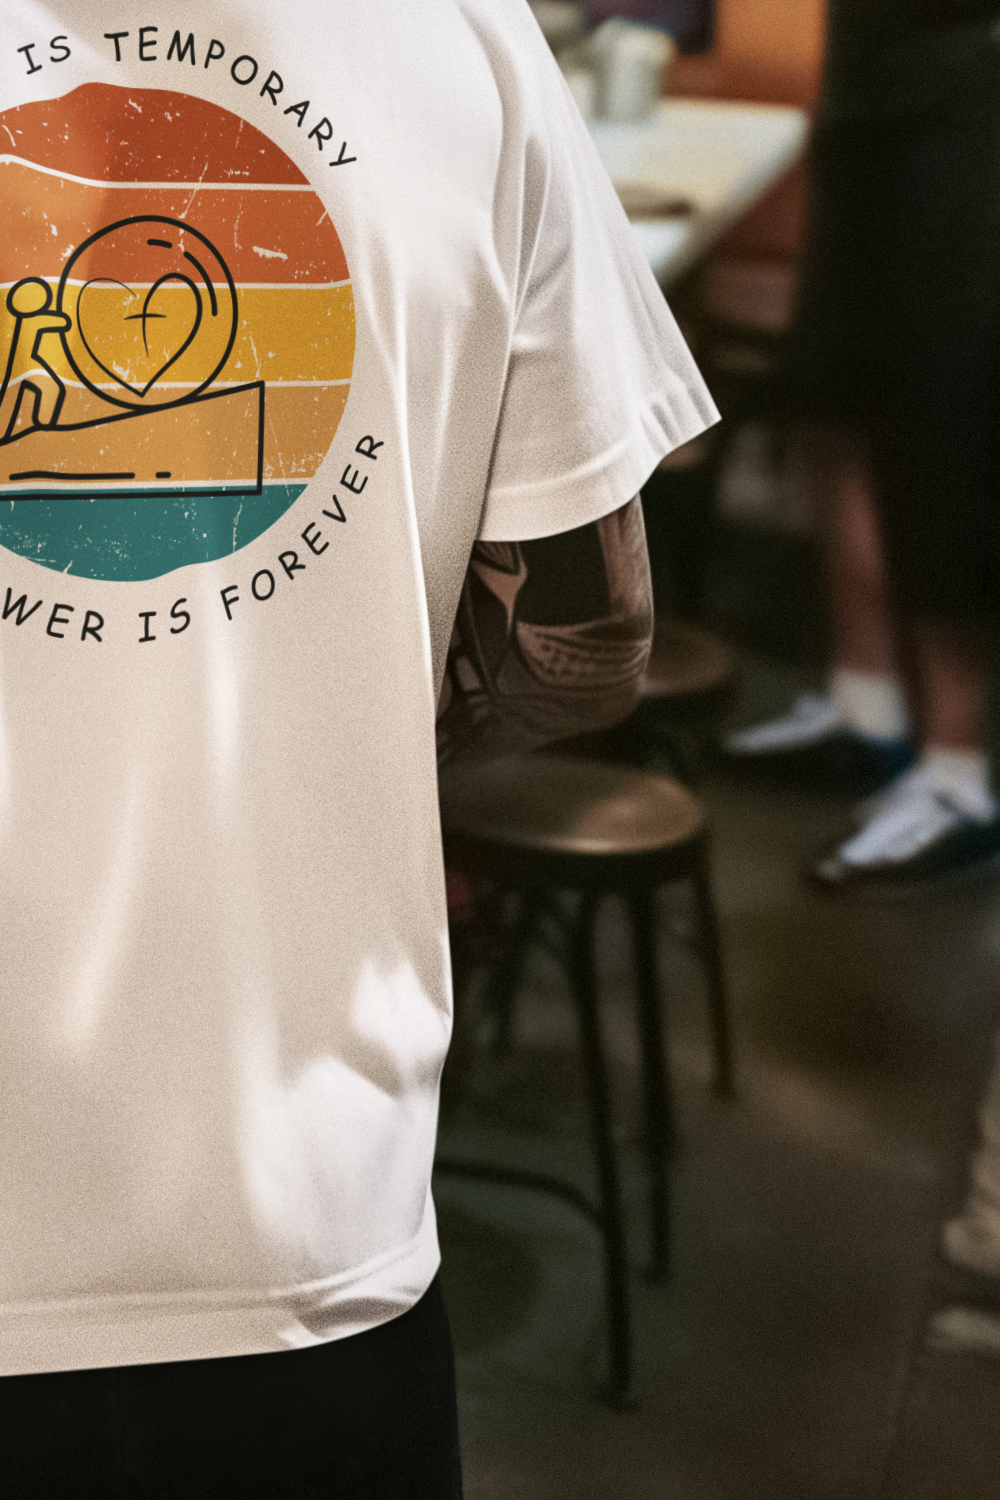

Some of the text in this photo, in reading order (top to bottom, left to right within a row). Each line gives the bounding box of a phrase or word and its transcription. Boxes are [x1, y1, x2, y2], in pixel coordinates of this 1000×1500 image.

[17, 35, 71, 75] IS
[103, 26, 357, 167] TEMPORARY
[138, 597, 191, 643] IS
[220, 435, 385, 621] FOREVER
